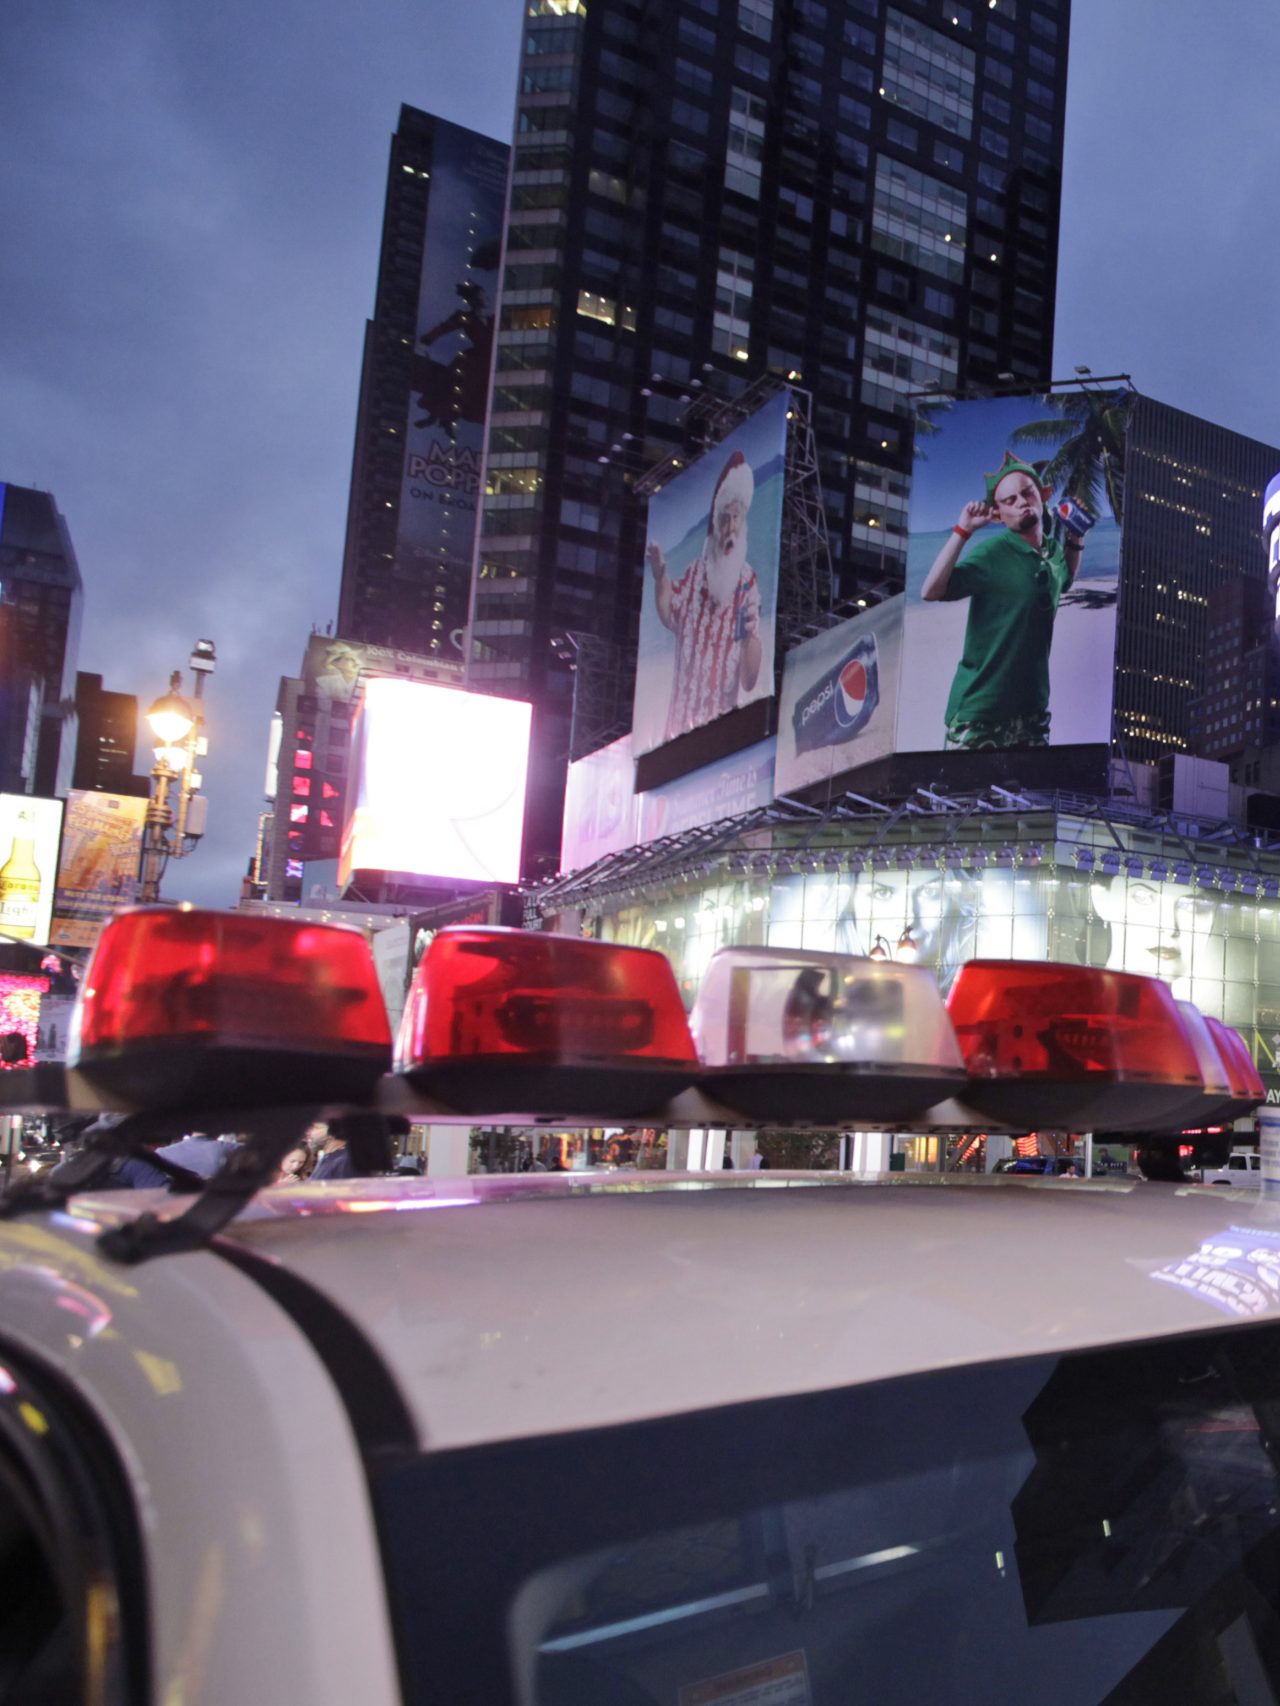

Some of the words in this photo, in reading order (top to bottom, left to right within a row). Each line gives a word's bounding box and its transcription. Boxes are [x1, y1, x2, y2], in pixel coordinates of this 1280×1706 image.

[430, 439, 482, 474] MA
[410, 487, 434, 500] ON
[802, 680, 834, 727] pepsi
